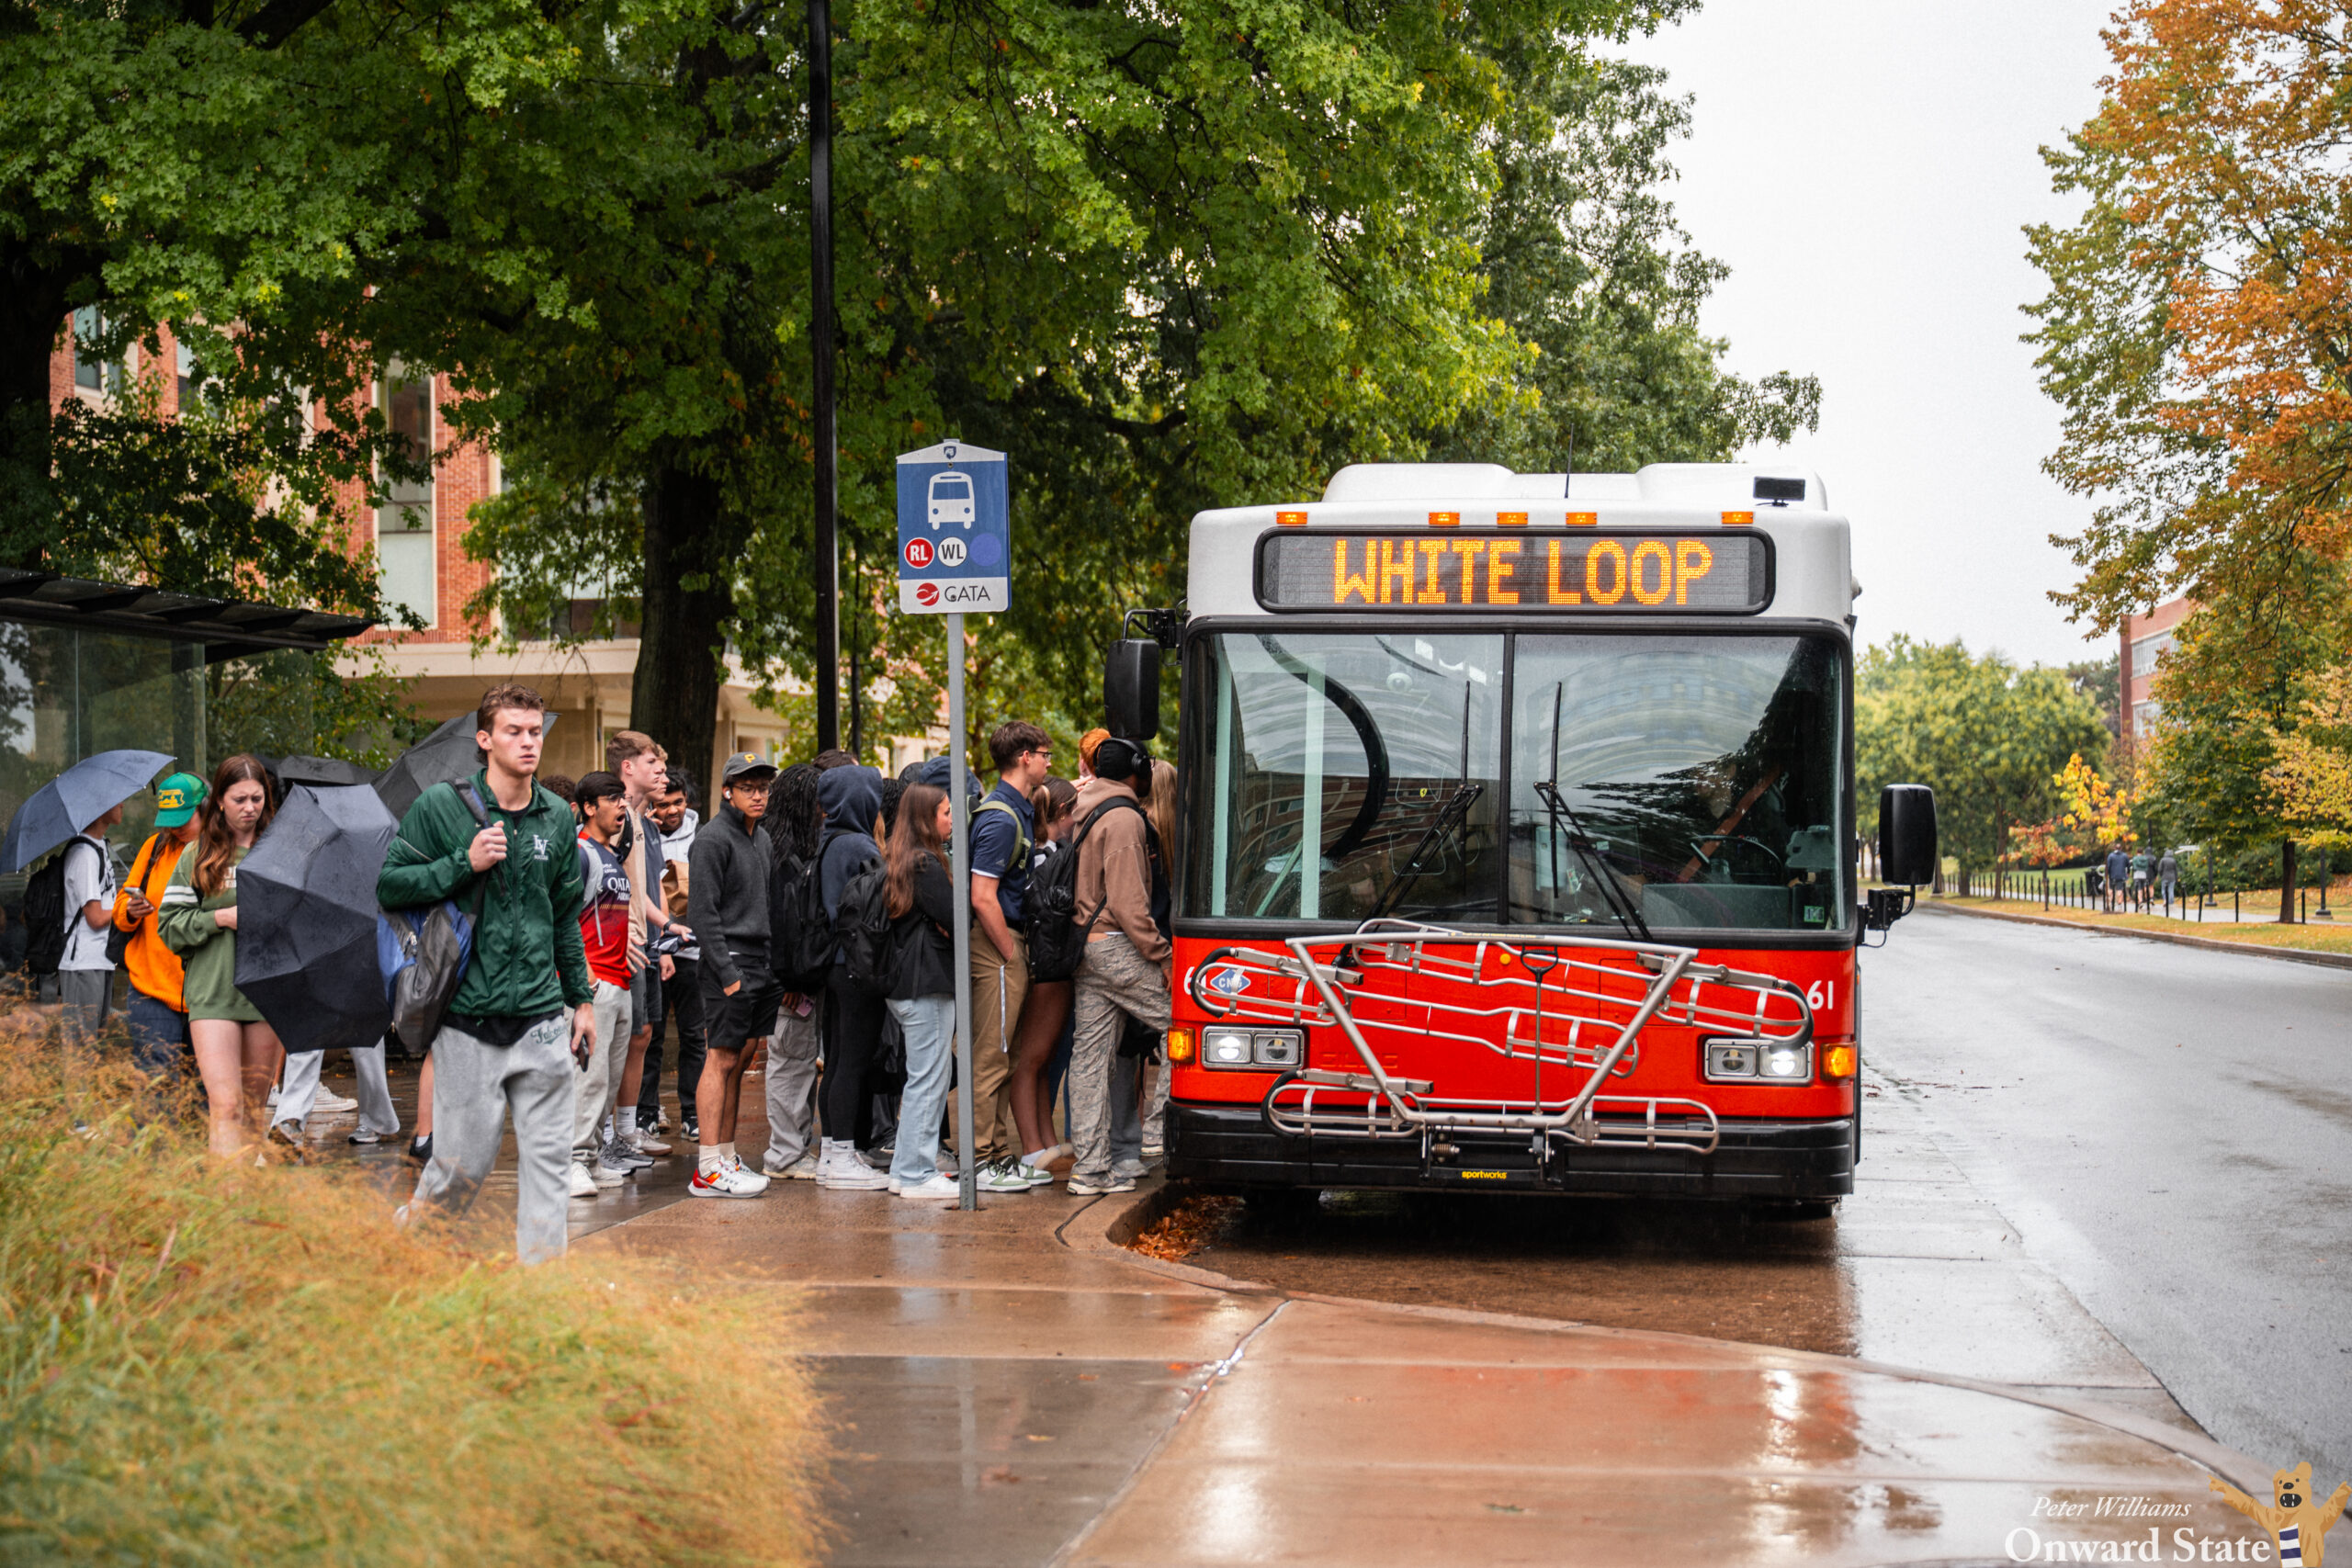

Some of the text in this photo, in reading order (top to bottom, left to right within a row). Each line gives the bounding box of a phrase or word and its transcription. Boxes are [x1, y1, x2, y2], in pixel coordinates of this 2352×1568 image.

[910, 544, 964, 561] RL WL
[1333, 538, 1713, 605] WHITE LOOP
[944, 586, 990, 602] CATA
[744, 753, 755, 763] P
[1806, 979, 1834, 1010] 61
[1462, 1170, 1507, 1179] sportworks
